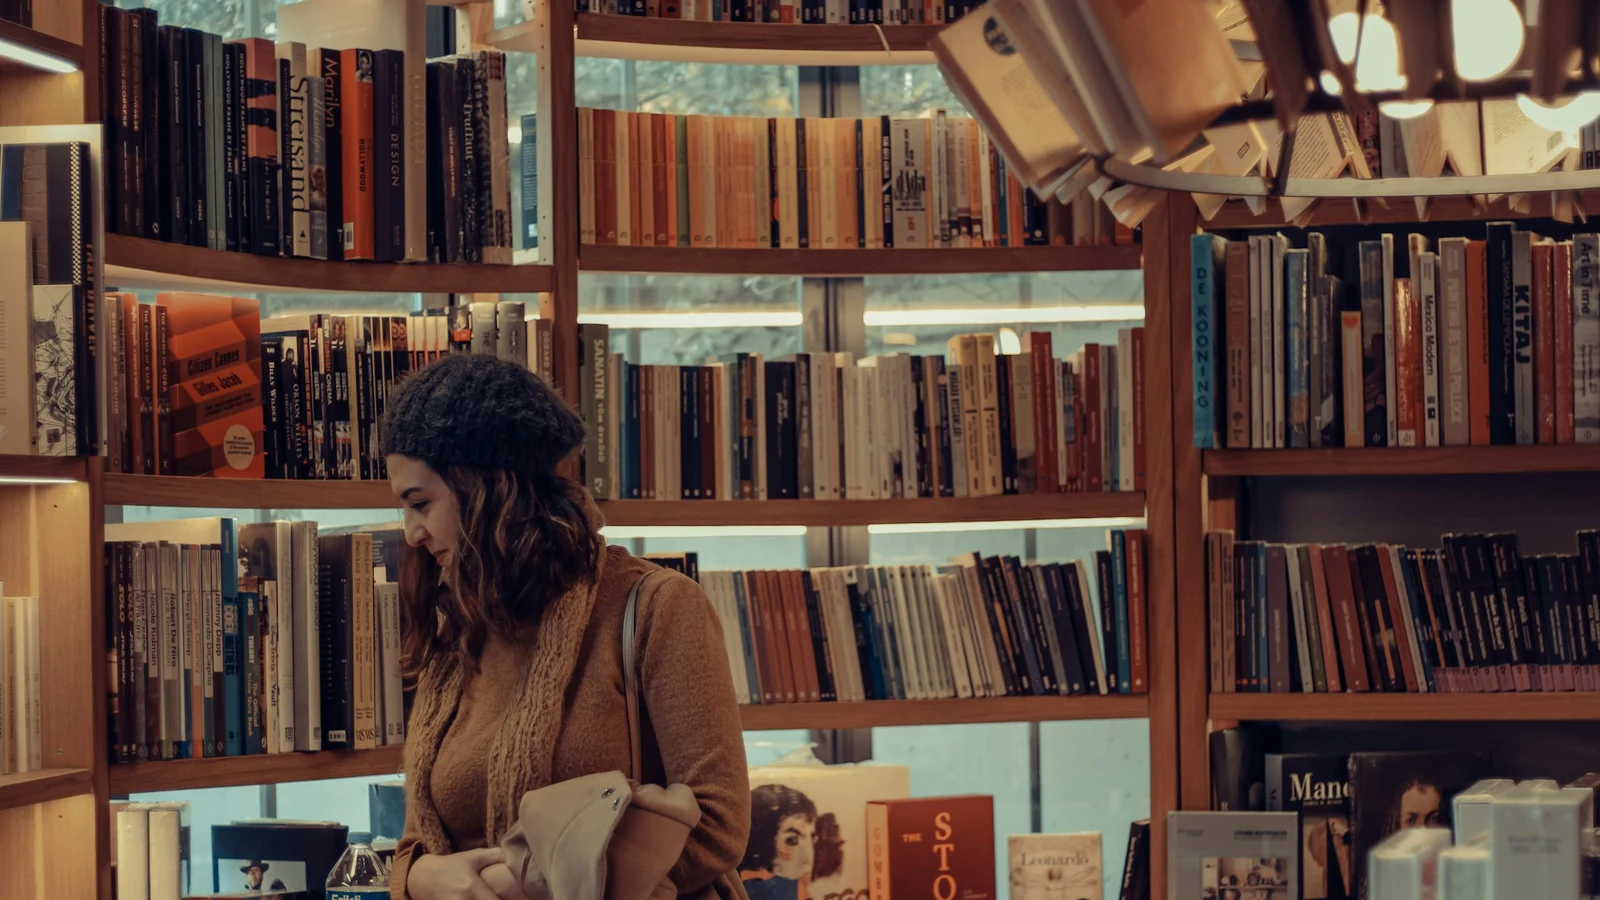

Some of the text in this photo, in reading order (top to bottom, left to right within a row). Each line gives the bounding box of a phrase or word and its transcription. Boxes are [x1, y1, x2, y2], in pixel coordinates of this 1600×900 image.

[324, 57, 339, 129] Marilyn
[290, 75, 309, 212] Streisand
[463, 103, 474, 161] Truffaut
[359, 138, 367, 192] HOLLYWOOD
[391, 132, 400, 187] DESIGN
[1581, 242, 1593, 263] Art
[1515, 284, 1530, 364] KITAJ
[1582, 282, 1594, 315] Time
[1197, 267, 1209, 408] DE KOONING
[1424, 294, 1435, 376] Mexico Modern
[187, 350, 240, 376] Citizen Cannes
[193, 371, 243, 397] Gilles Jacob
[268, 361, 276, 386] BILLY
[593, 338, 605, 400] SANATIN
[269, 389, 277, 423] WILDER
[149, 592, 158, 666] Nicole Kidman
[901, 833, 923, 843] THE
[1021, 852, 1090, 866] Leonardo
